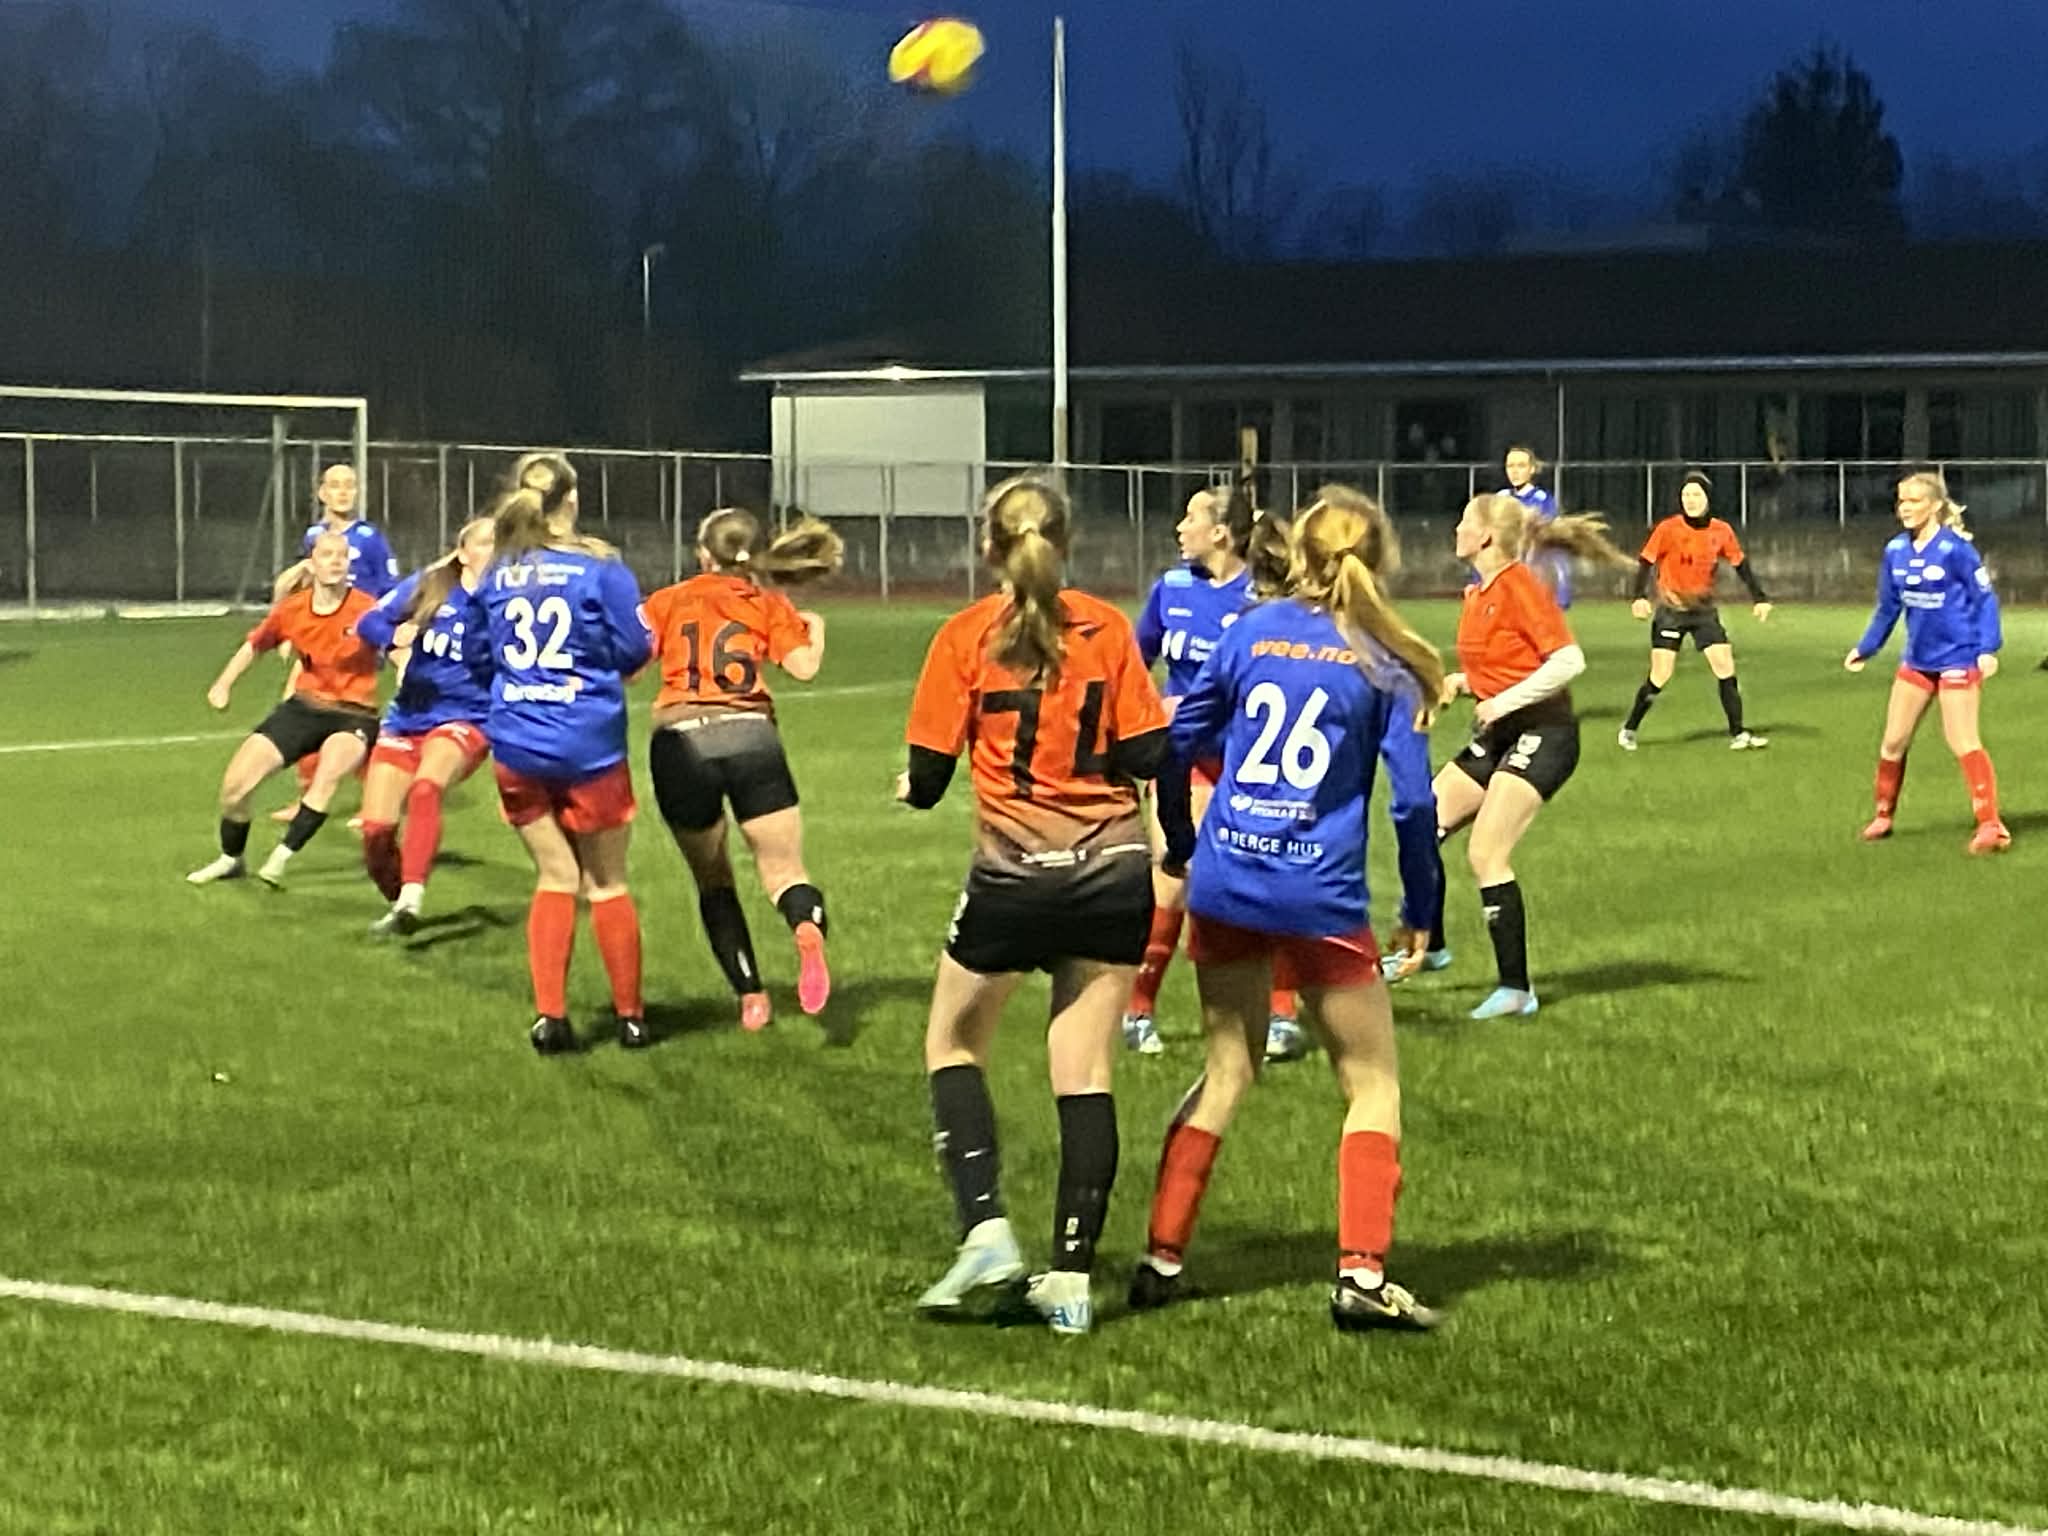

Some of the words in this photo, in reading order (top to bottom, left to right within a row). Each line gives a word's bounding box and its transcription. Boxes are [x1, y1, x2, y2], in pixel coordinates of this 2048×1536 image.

[503, 596, 574, 670] 32
[681, 620, 756, 694] 16
[1236, 682, 1331, 789] 26
[1230, 830, 1281, 854] BERGE
[1287, 840, 1323, 858] HUS
